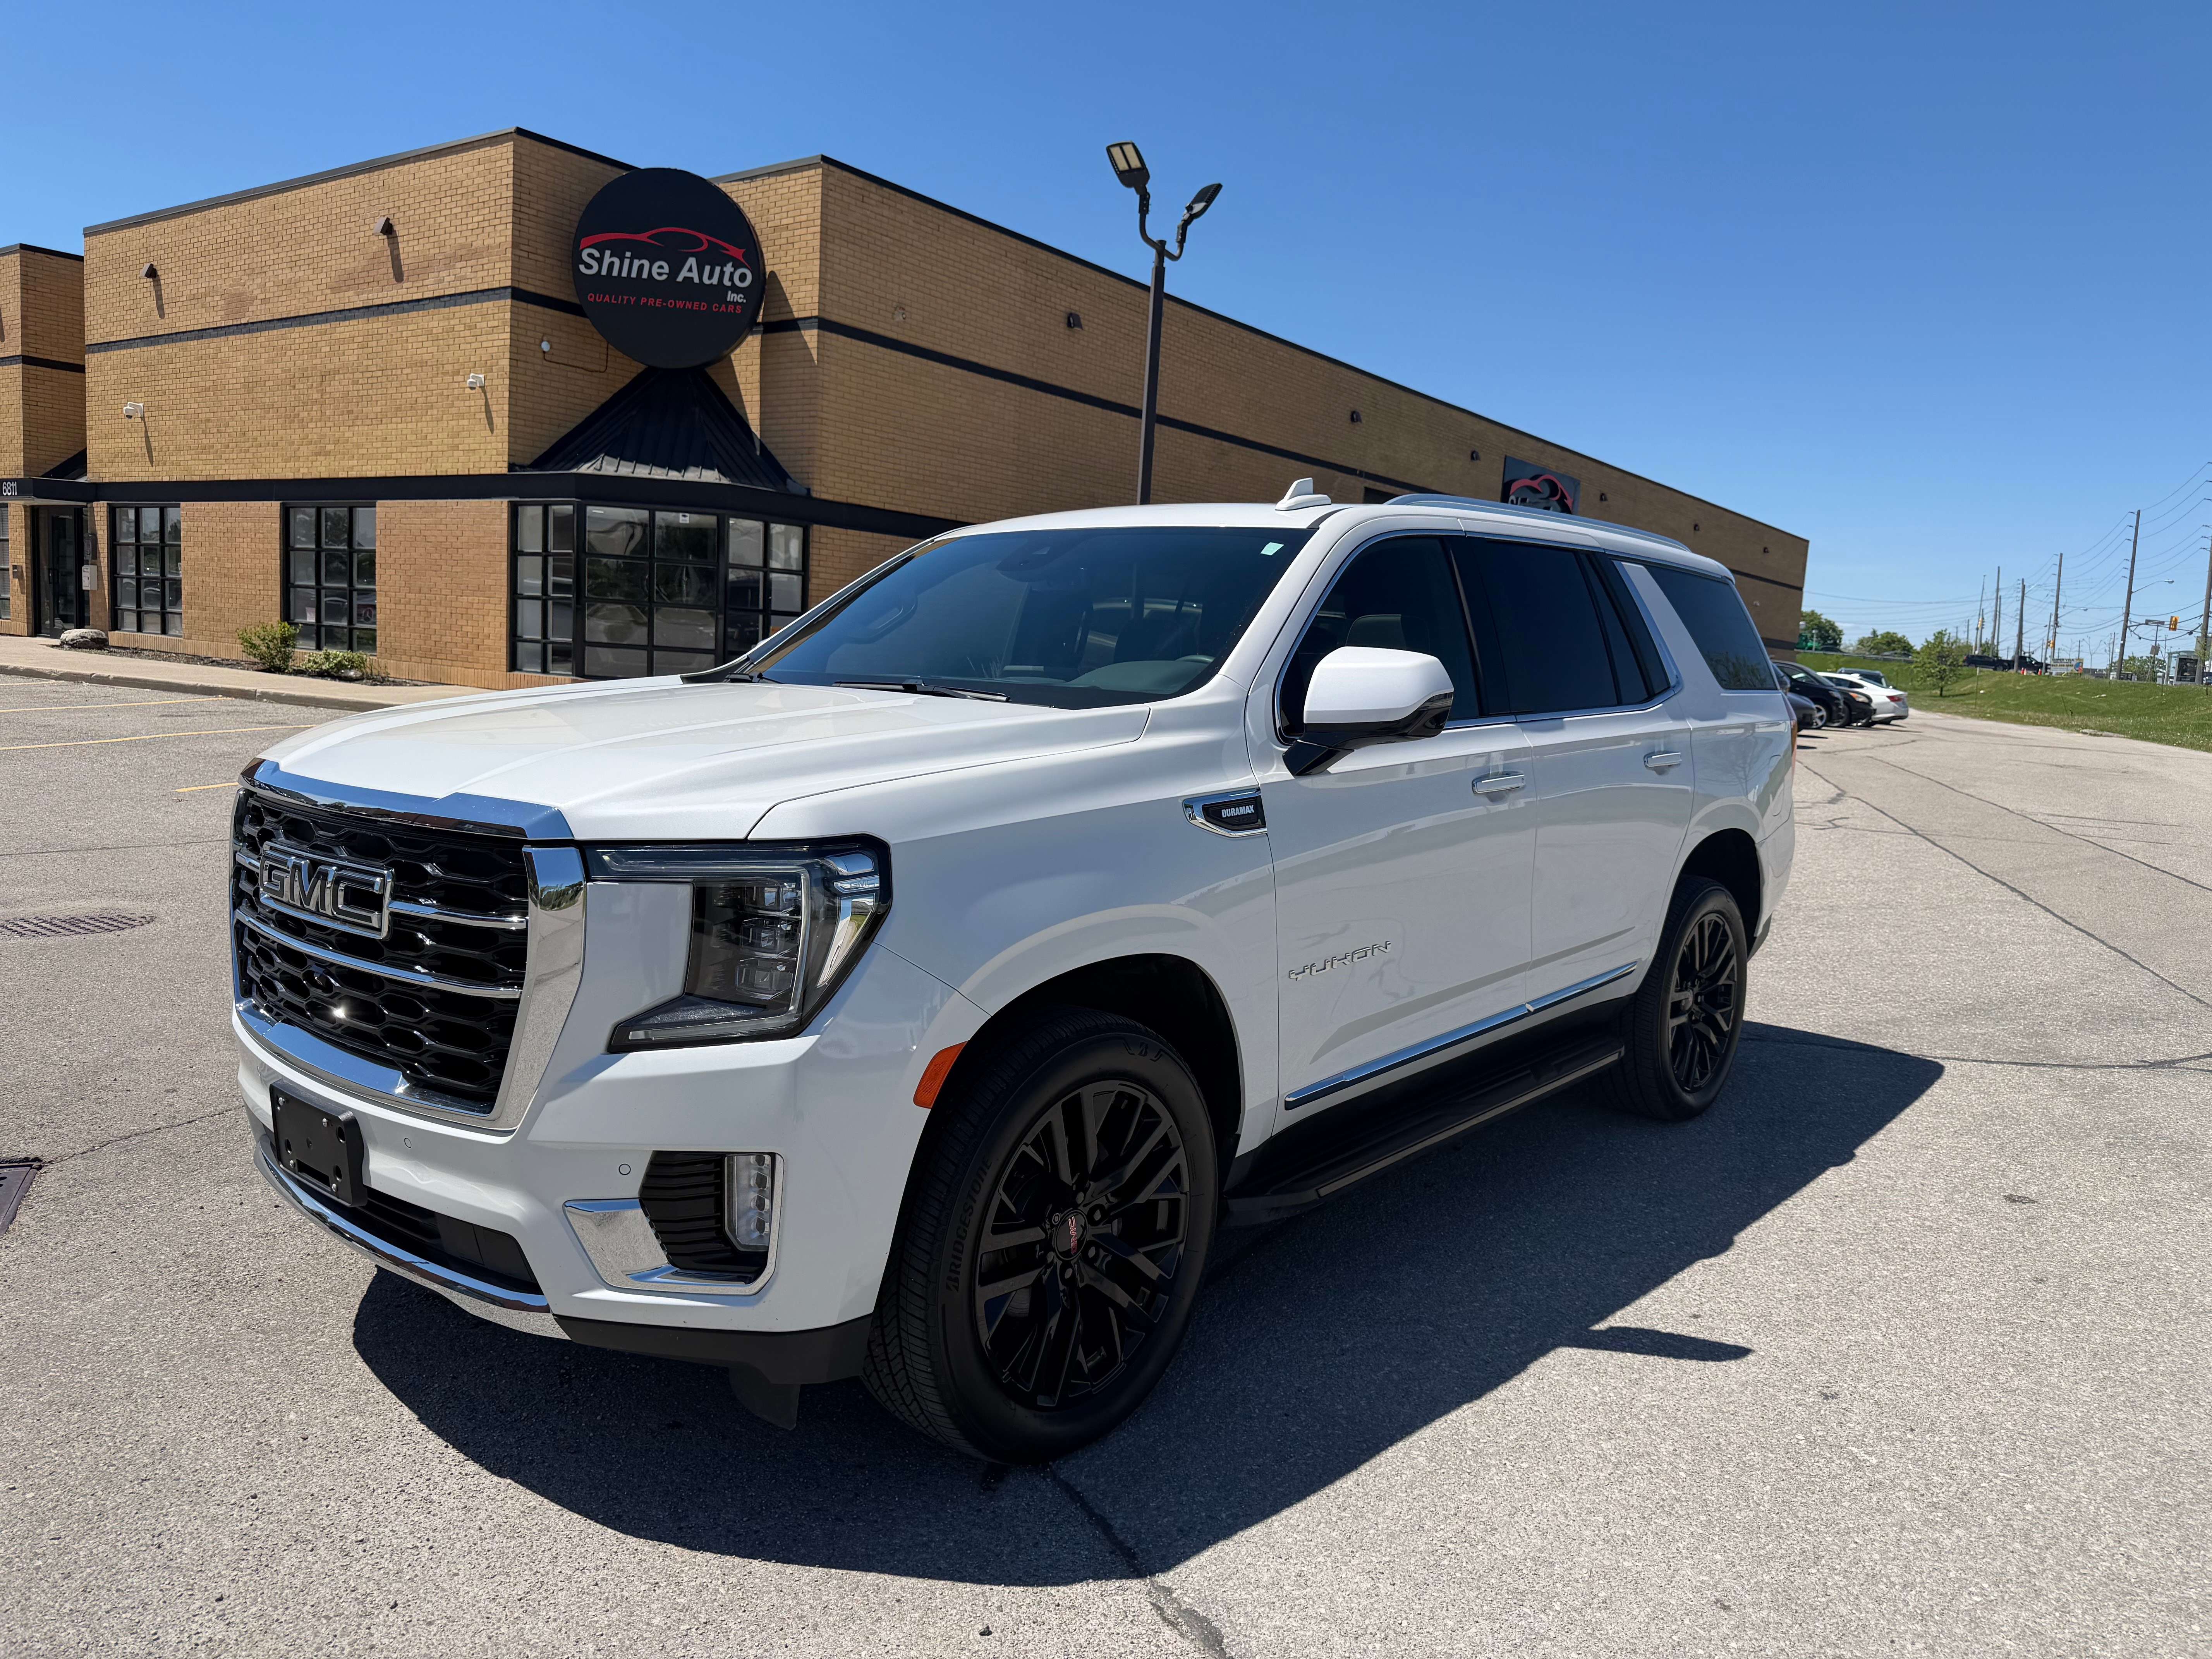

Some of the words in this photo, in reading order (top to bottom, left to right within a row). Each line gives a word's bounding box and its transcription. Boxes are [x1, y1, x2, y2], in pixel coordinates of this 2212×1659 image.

[579, 248, 669, 281] Shine
[676, 257, 752, 288] Auto
[587, 293, 635, 305] QUALITY
[641, 297, 707, 311] PRE-OWNED
[712, 304, 742, 314] CARS
[726, 290, 747, 303] Inc.
[2, 481, 17, 496] 6811
[1221, 804, 1255, 818] DURAMAX
[260, 850, 384, 929] GMC
[1288, 941, 1391, 981] YUKON
[945, 1153, 993, 1292] BRIDGESTONE
[1068, 1216, 1079, 1255] GMC
